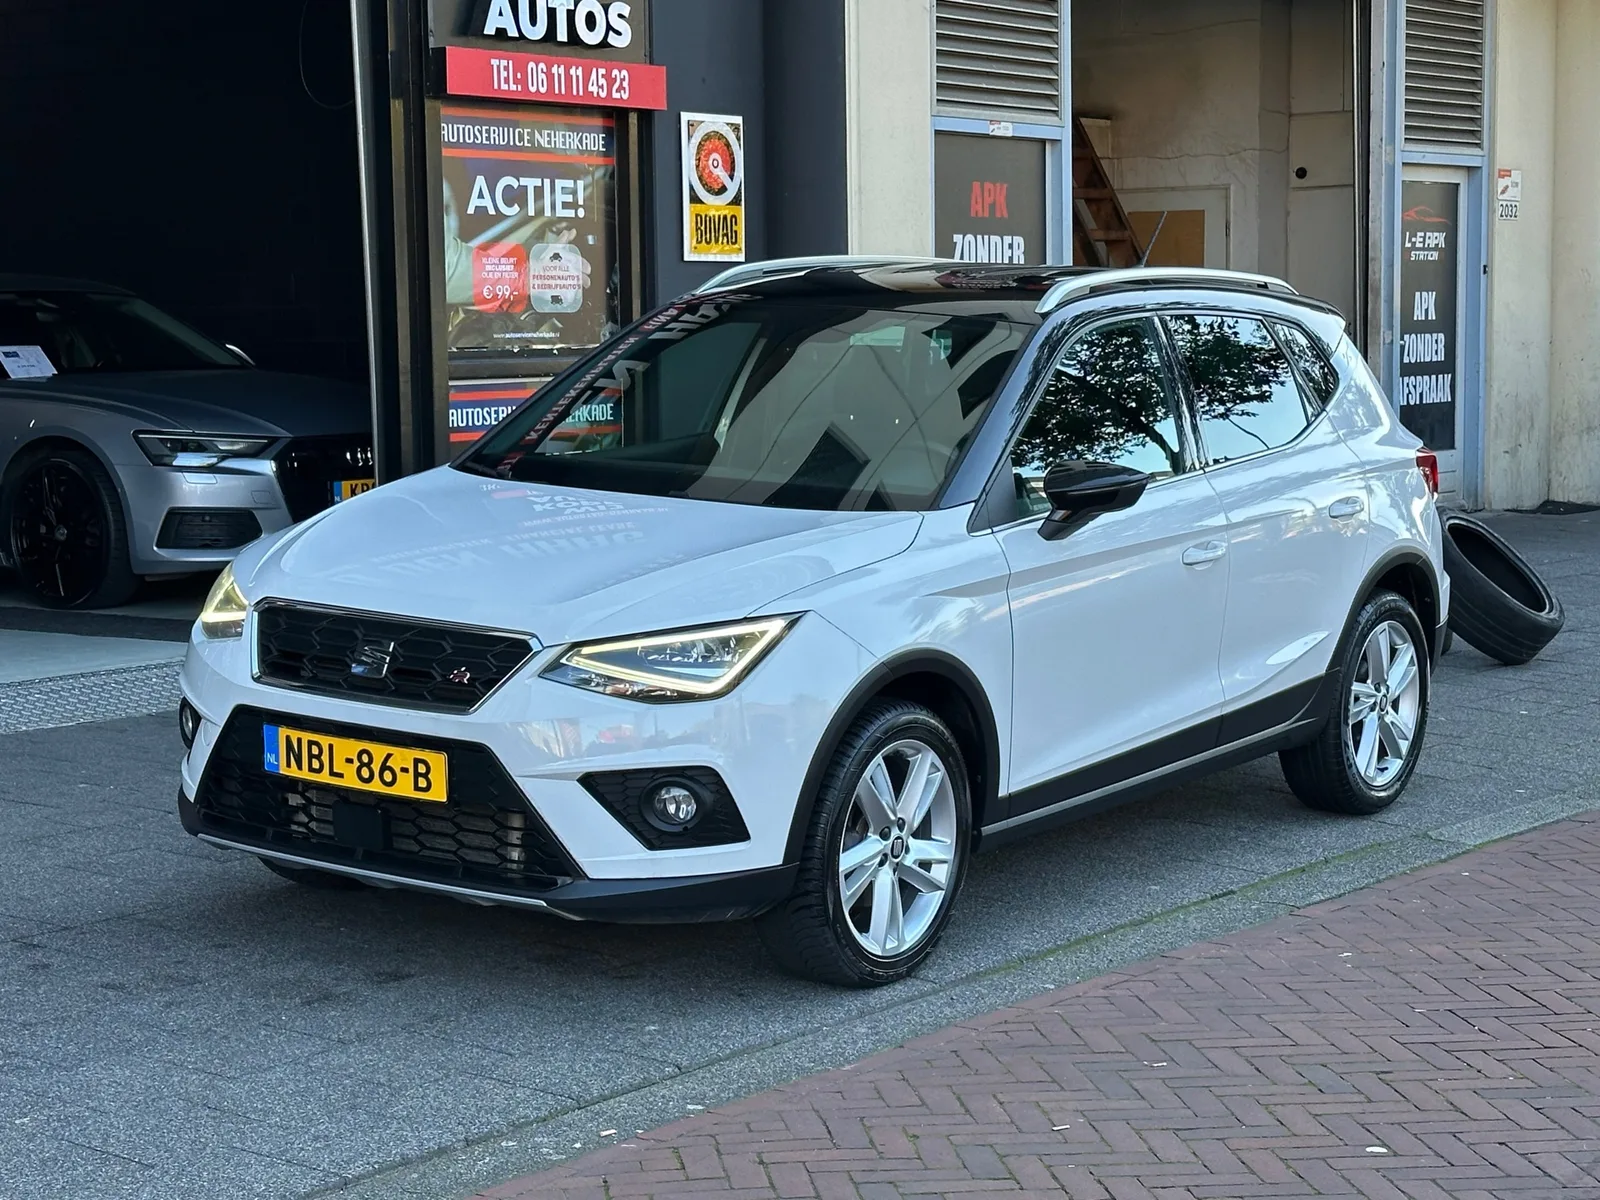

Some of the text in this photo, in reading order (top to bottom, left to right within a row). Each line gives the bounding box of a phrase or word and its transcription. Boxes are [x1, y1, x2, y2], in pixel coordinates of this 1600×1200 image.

[483, 0, 632, 48] AUTOS
[490, 58, 630, 100] TEL: 06 11 11 45 23
[534, 129, 606, 151] NEHERKADE
[466, 174, 585, 219] ACTIE!
[970, 181, 1009, 218] APK
[1499, 203, 1518, 219] 2032
[694, 212, 738, 246] BOVAG
[1424, 231, 1446, 248] APK
[953, 233, 1025, 264] ZONDER
[1410, 250, 1438, 260] STATION
[532, 274, 580, 282] PERSONENAUTO'S
[1413, 291, 1436, 321] APK
[1403, 333, 1445, 363] ZONDER
[266, 734, 433, 793] NL NBL-86-B
